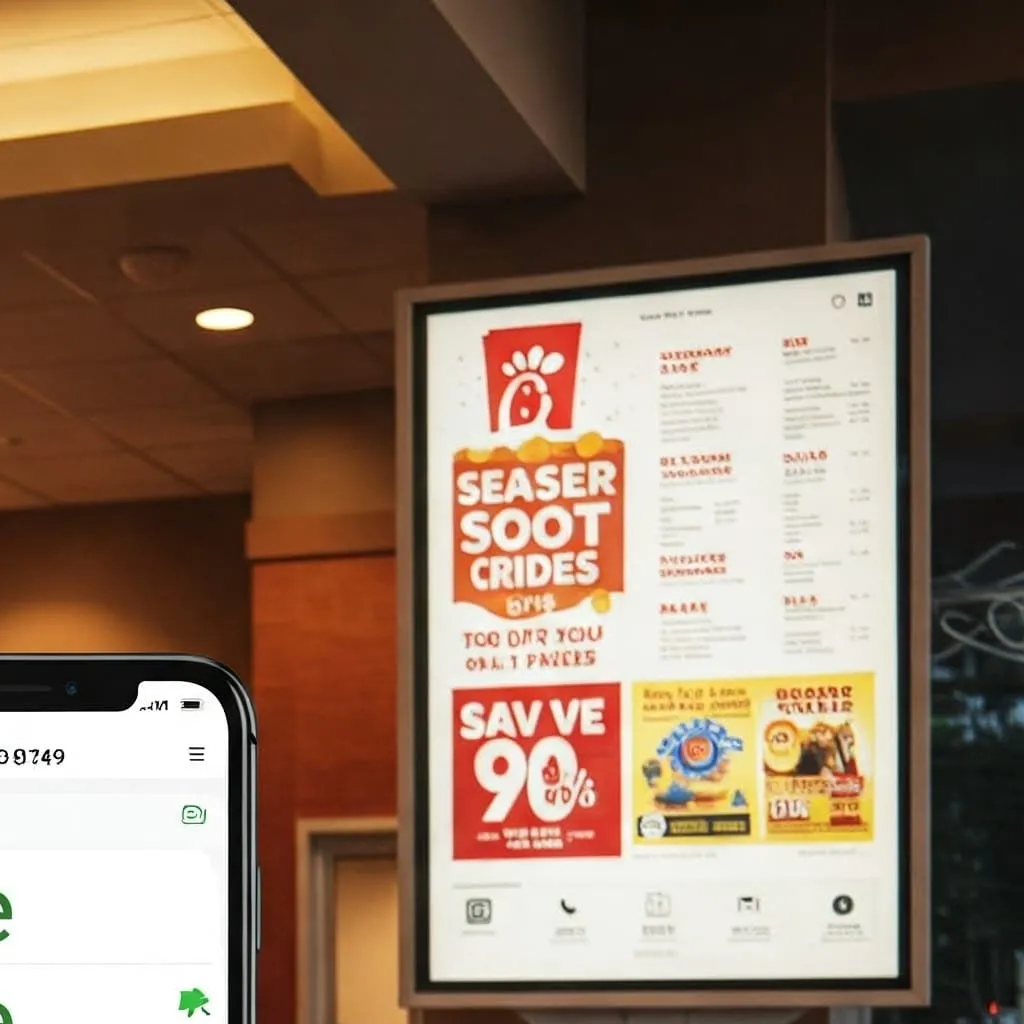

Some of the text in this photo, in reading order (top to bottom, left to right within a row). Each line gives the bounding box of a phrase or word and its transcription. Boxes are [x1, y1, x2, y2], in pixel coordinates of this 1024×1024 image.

[457, 460, 617, 506] SEASER
[460, 501, 612, 554] SOOT
[470, 550, 600, 591] CRIDES
